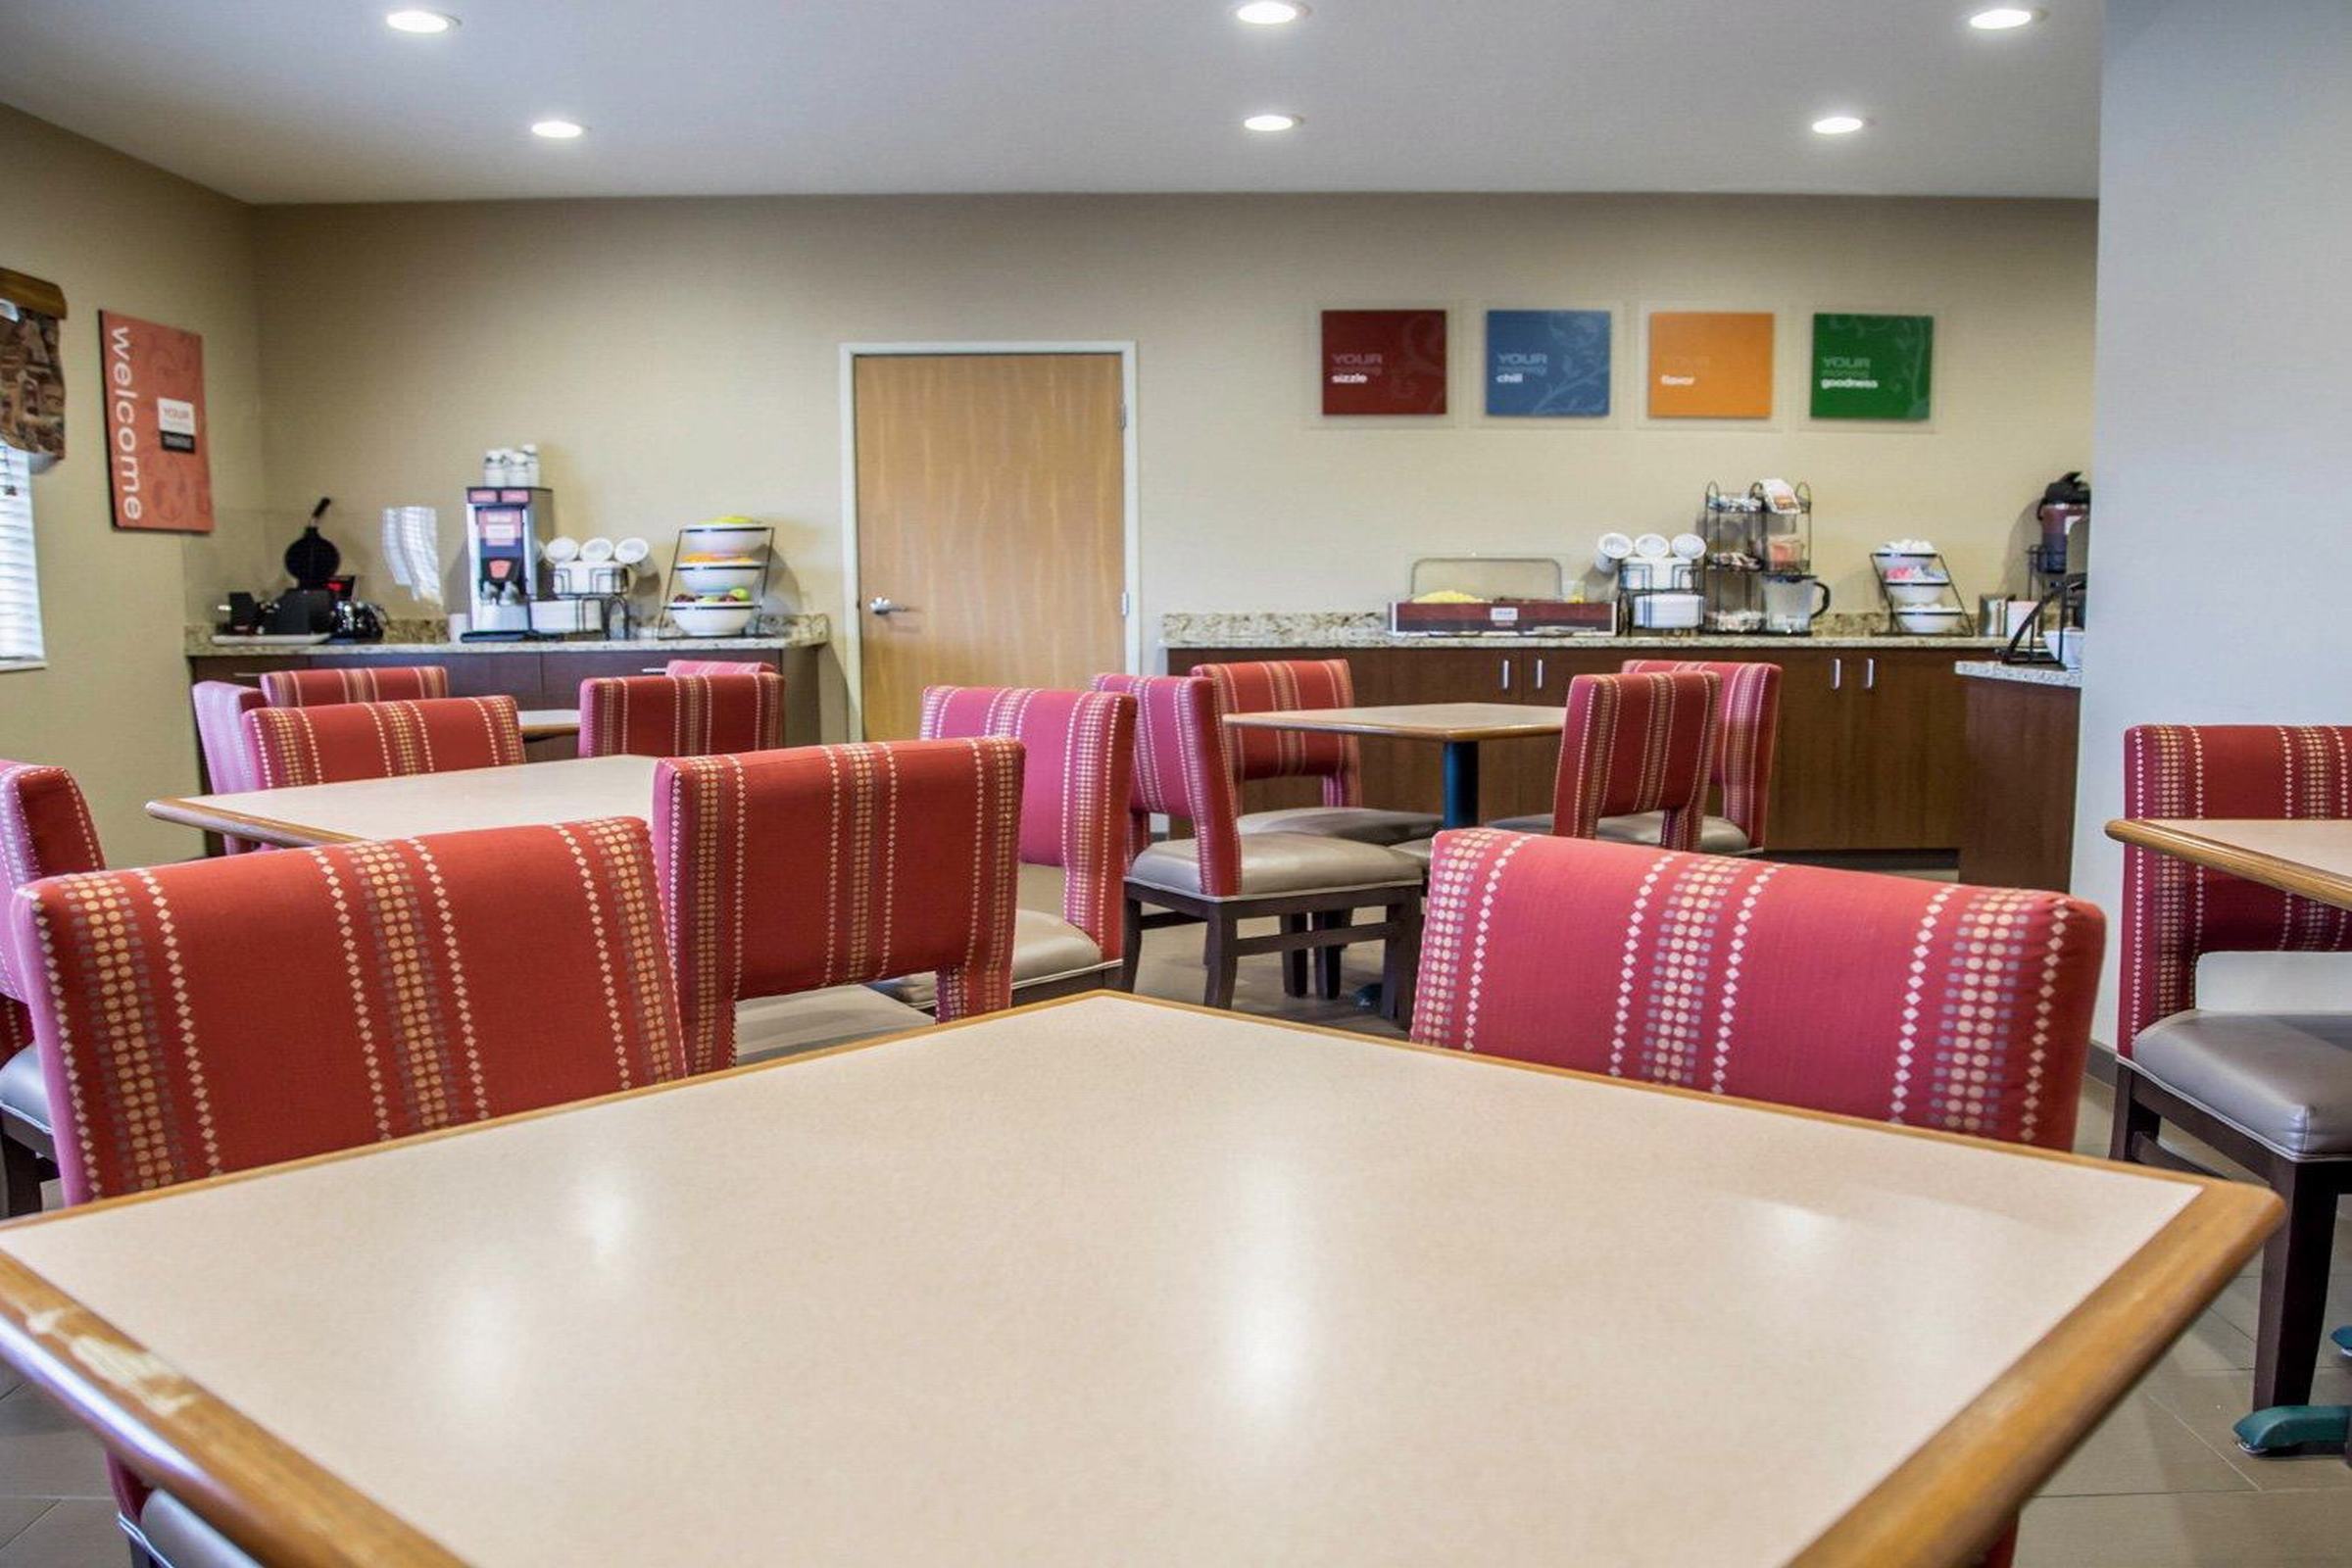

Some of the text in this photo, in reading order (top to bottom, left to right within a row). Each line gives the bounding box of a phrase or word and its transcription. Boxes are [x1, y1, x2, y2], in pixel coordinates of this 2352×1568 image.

[1332, 353, 1382, 364] YOUR
[1496, 353, 1548, 364] YOUR
[1823, 357, 1871, 368] YOUR
[1332, 372, 1367, 383] sizzle
[1495, 372, 1523, 383] chill
[1821, 377, 1879, 390] goodness
[112, 326, 142, 519] welcome
